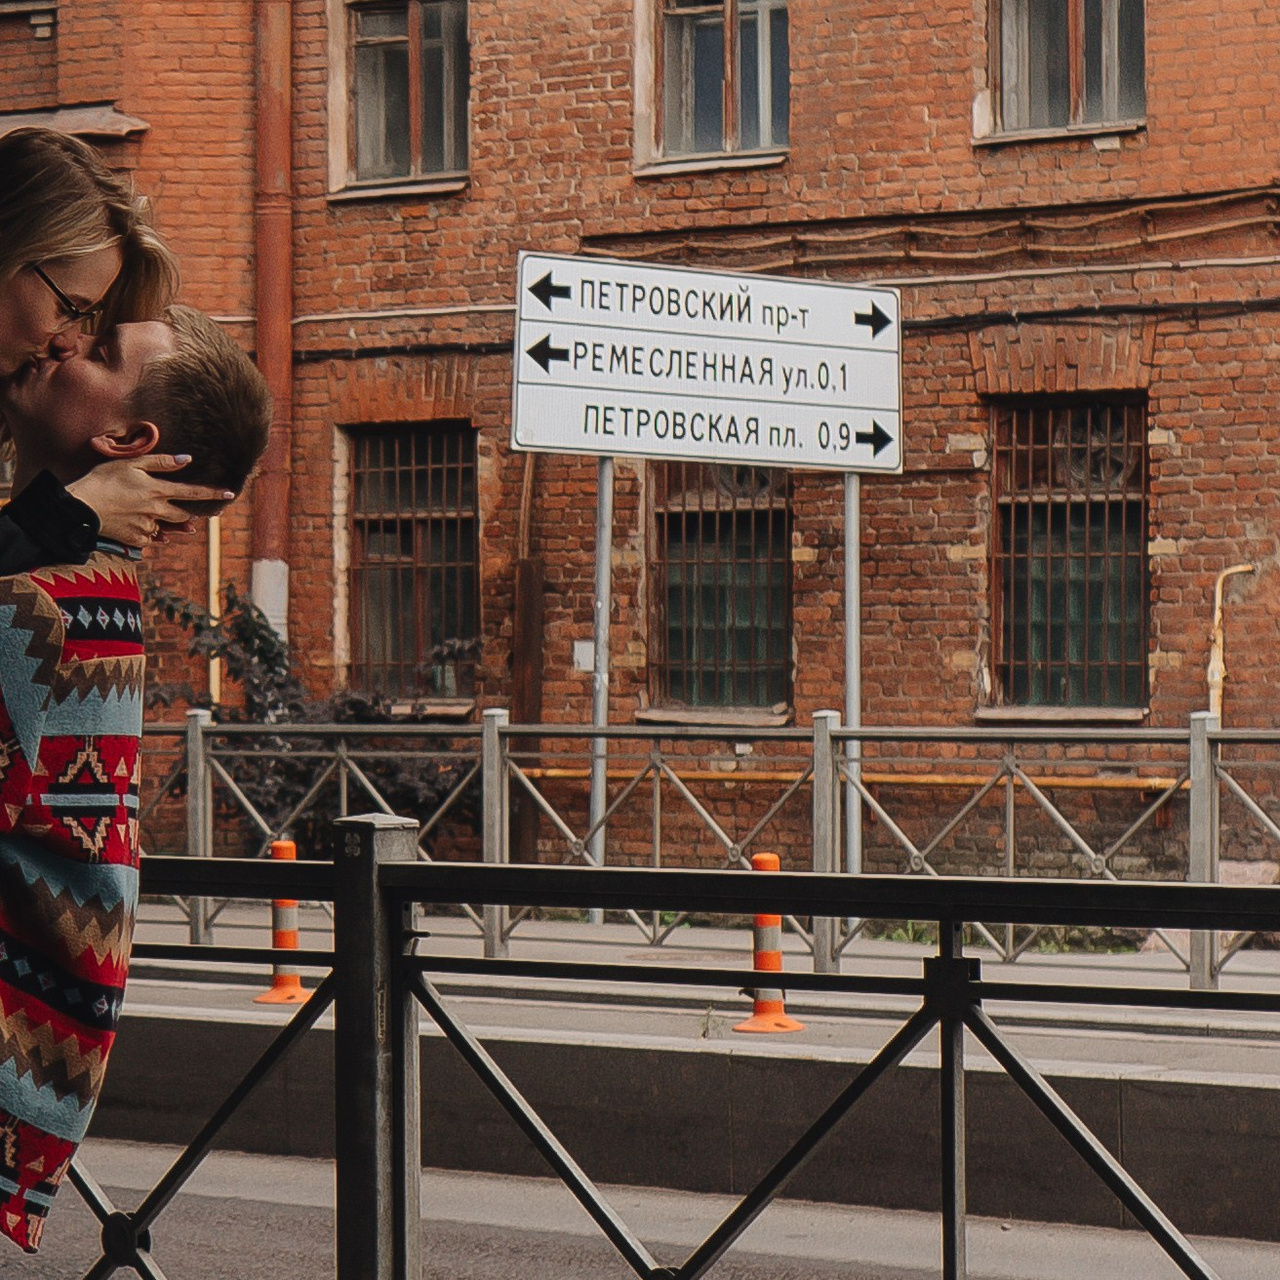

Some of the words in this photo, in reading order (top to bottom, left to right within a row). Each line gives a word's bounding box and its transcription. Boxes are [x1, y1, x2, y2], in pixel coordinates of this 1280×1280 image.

[580, 279, 752, 324] ПЕТРОВСКИЙ
[761, 304, 810, 334] пр-т
[574, 341, 774, 385] РЕМЕСЛЕННАЯ
[584, 404, 759, 446] ПЕТРОВСКАЯ
[769, 425, 803, 449] пл.
[819, 422, 851, 453] 0,9
